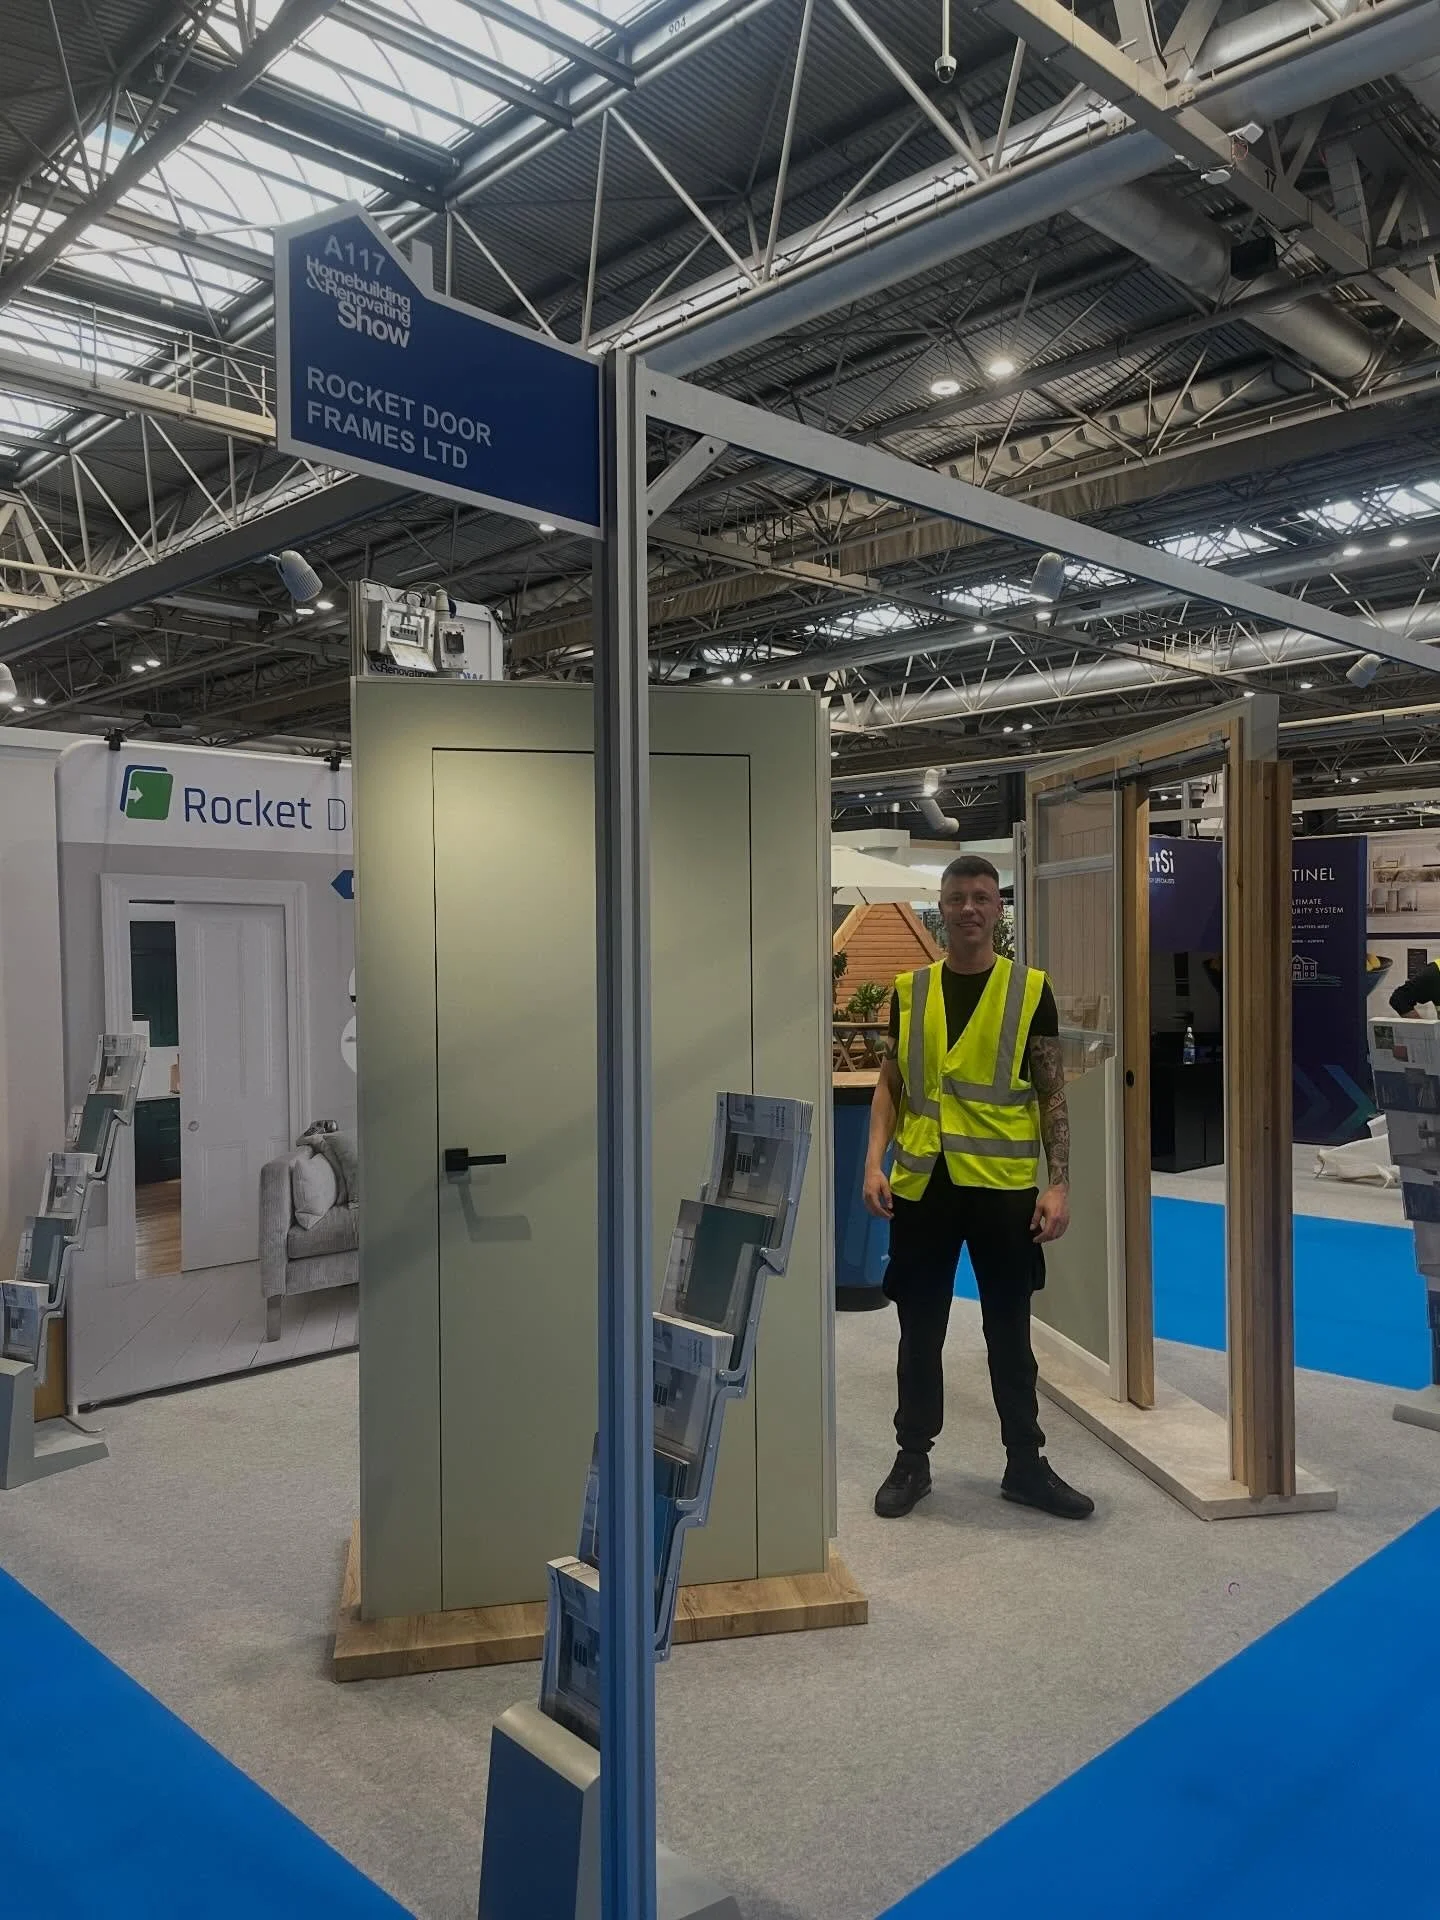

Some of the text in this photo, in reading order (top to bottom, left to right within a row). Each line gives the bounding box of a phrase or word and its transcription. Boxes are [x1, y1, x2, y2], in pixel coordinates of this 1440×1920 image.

[1264, 168, 1277, 193] 17
[324, 234, 386, 276] A117
[306, 254, 411, 313] Homebuilding
[337, 299, 410, 349] Show
[307, 365, 492, 447] ROCKET DOOR
[307, 400, 468, 469] FRAMES LTD
[184, 787, 347, 831] Rocket D
[1291, 867, 1335, 882] TINEL
[1315, 906, 1344, 914] SYSTEM
